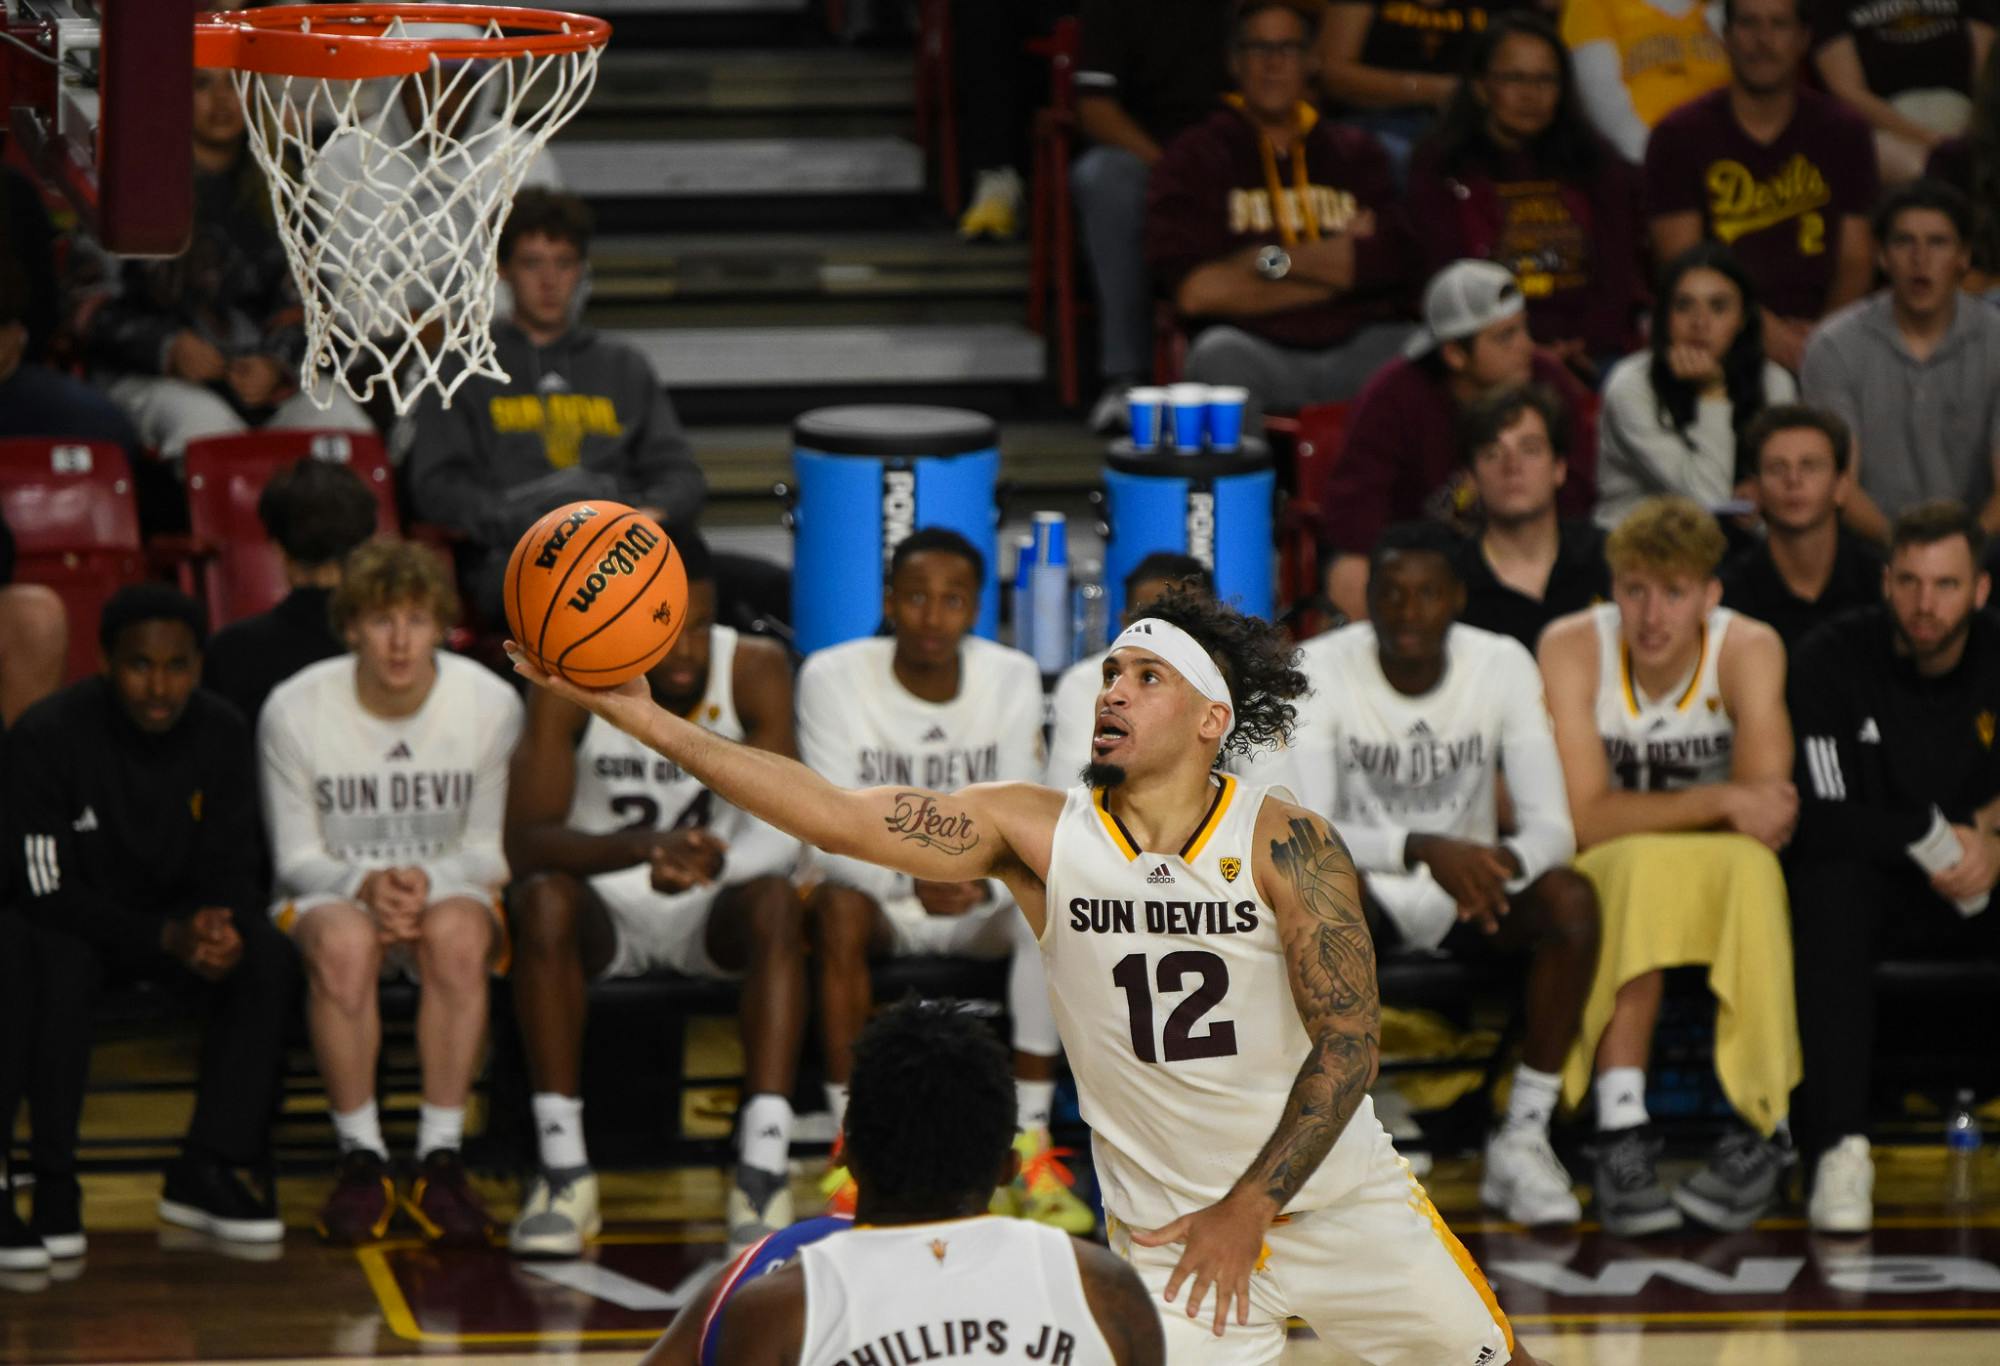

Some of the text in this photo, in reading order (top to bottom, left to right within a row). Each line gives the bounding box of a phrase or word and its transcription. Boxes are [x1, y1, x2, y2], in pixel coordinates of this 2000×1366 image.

[1799, 212, 1826, 255] 2
[535, 506, 598, 569] NCAA
[884, 470, 915, 575] POW
[1188, 492, 1215, 570] POW
[567, 523, 660, 613] Wilson
[858, 747, 914, 786] SUN
[315, 775, 379, 814] SUN
[884, 792, 975, 840] Fear
[1146, 875, 1176, 884] adidas
[1225, 868, 1237, 880] 12
[1069, 897, 1259, 936] SUN DEVILS
[1112, 950, 1238, 1065] 12
[1026, 1324, 1076, 1366] JR
